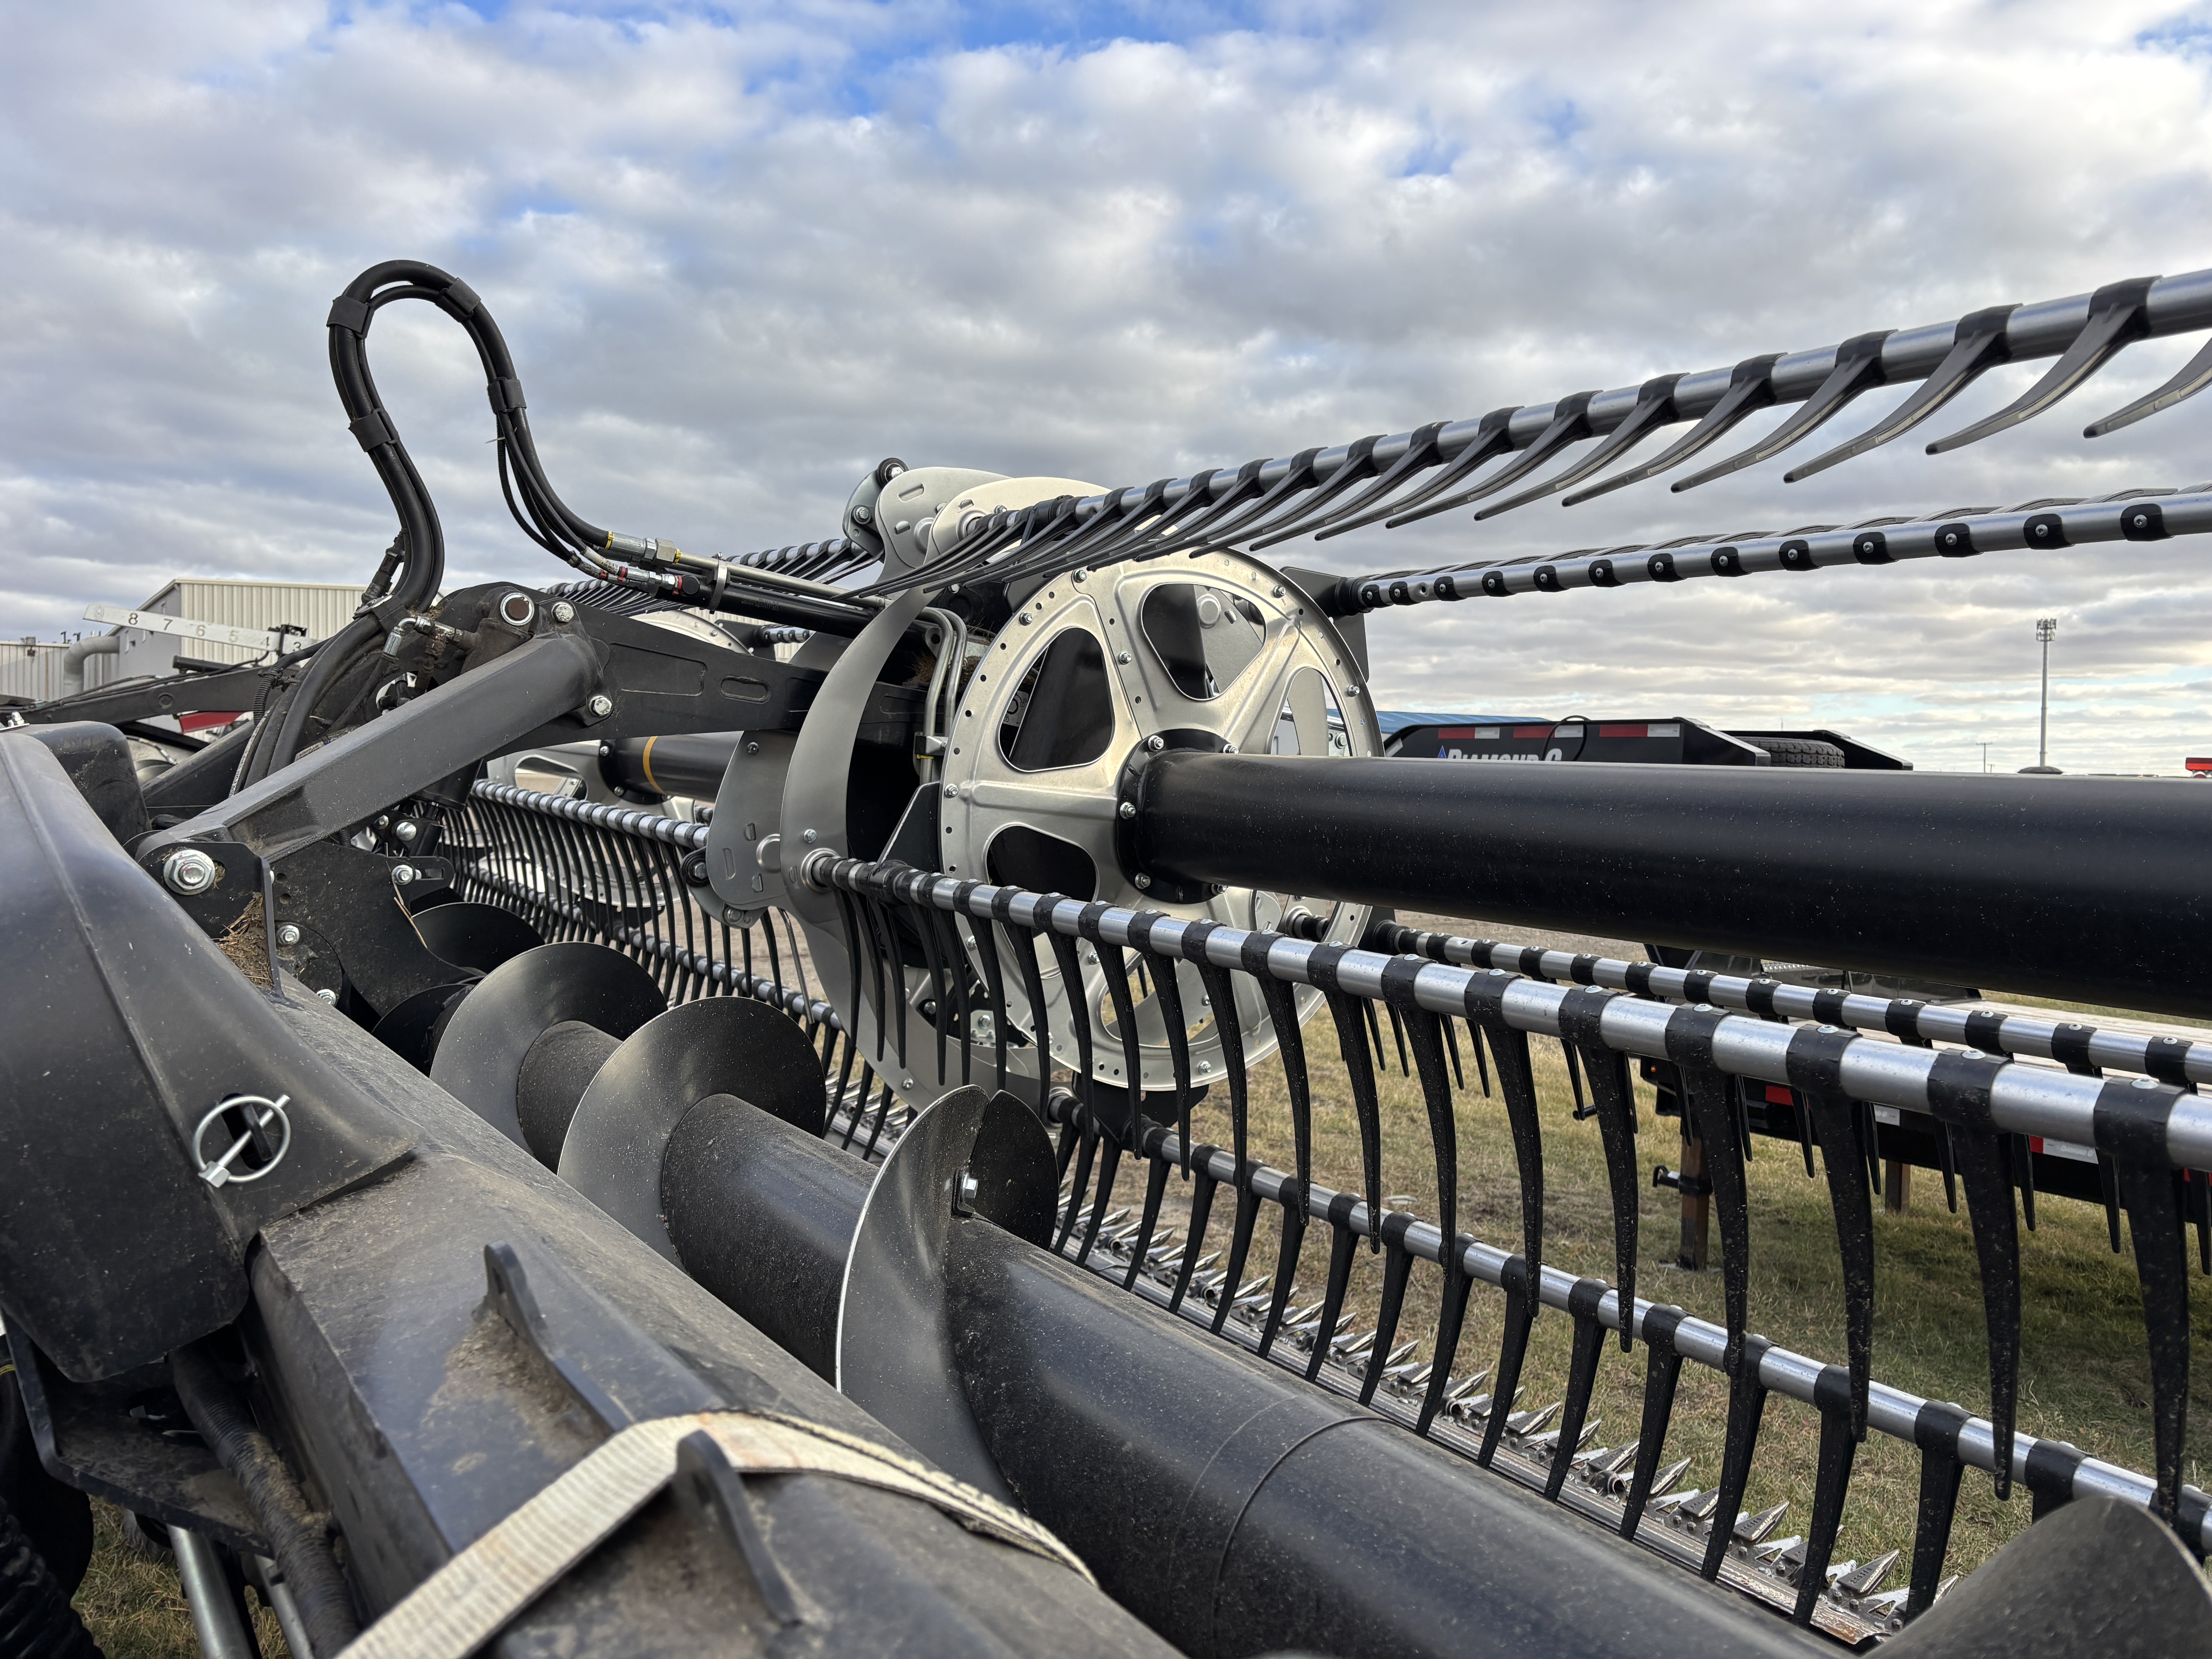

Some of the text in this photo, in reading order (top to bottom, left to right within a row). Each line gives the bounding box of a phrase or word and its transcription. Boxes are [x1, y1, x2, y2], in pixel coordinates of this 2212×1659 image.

[128, 613, 138, 625] 8
[163, 618, 173, 631] 7
[195, 625, 206, 637] 6
[228, 630, 239, 642] 5
